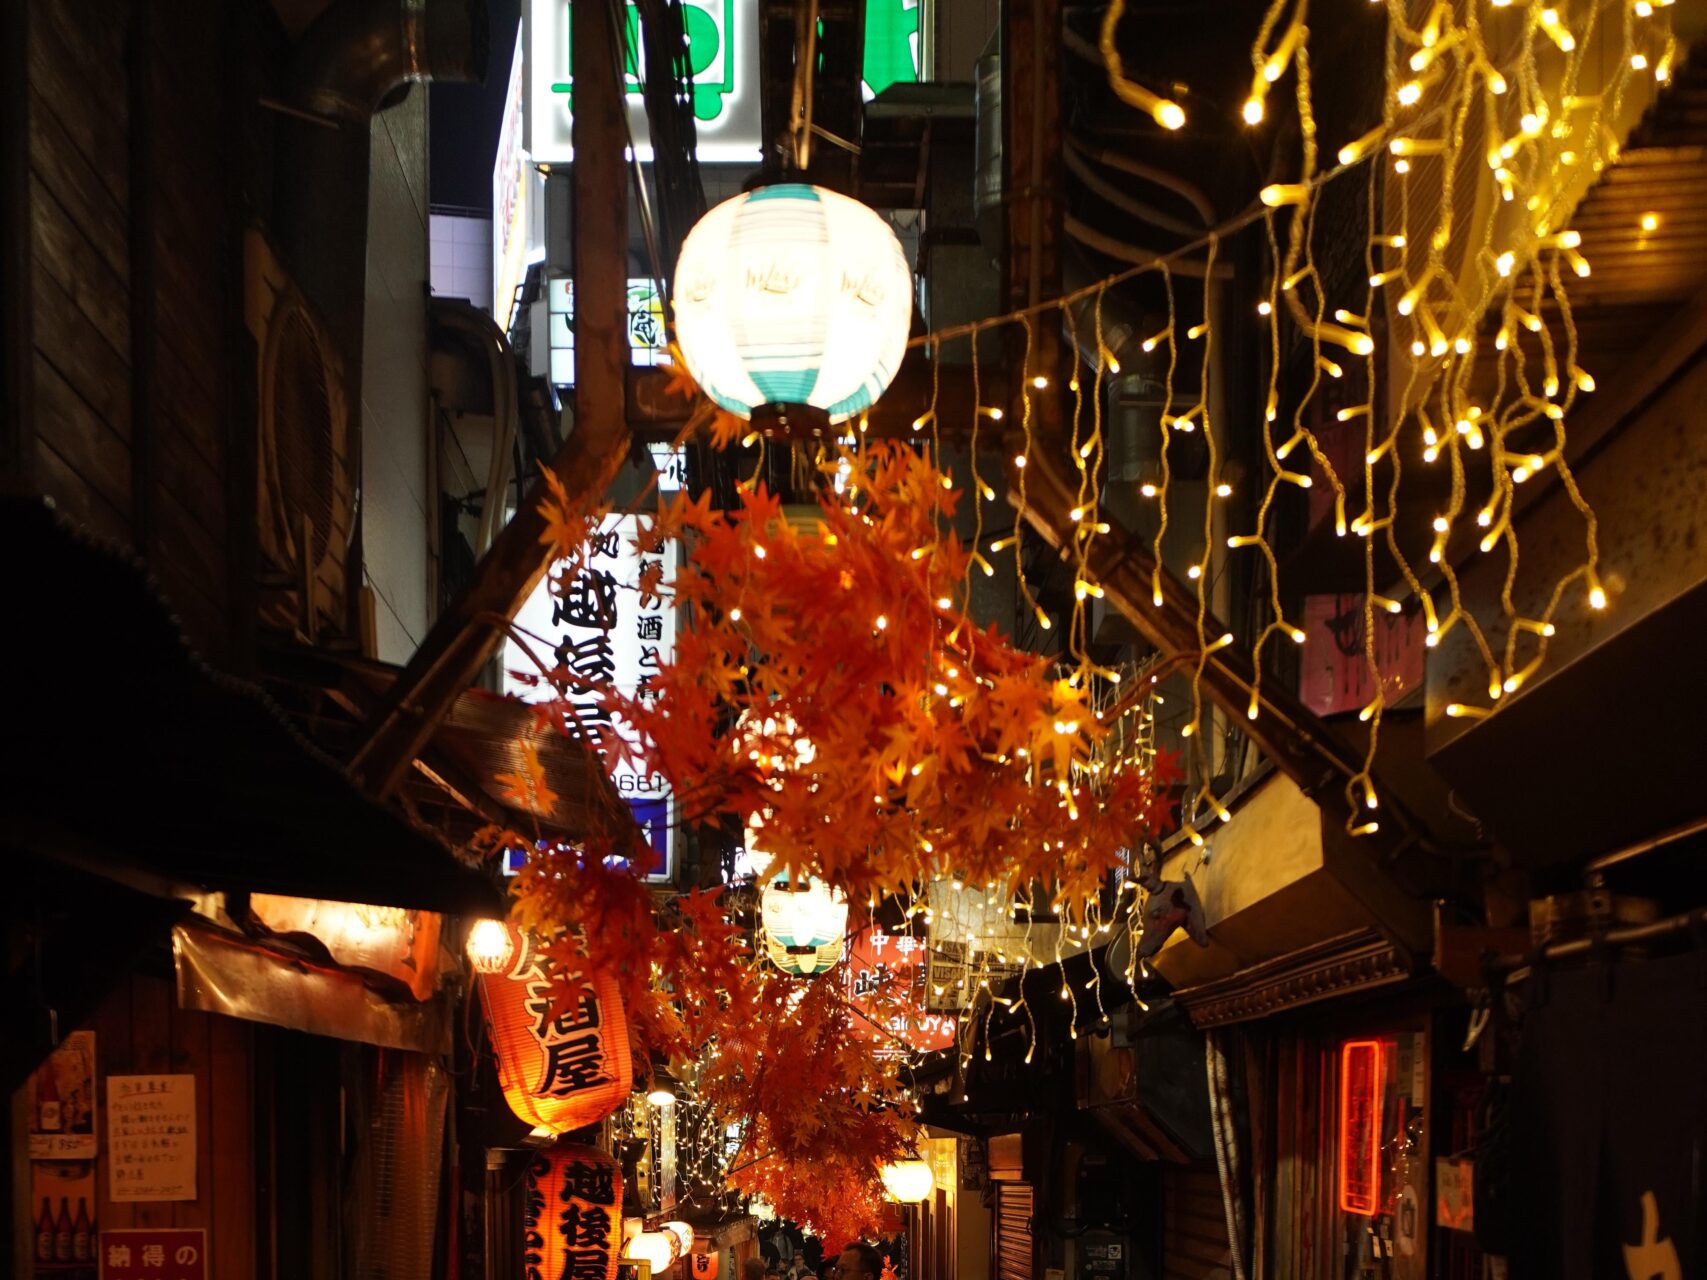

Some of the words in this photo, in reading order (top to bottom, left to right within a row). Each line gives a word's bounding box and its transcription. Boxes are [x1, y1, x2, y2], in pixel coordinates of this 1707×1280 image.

[612, 775, 663, 793] 661
[869, 929, 926, 957] 中華
[107, 1245, 198, 1268] 納得の
